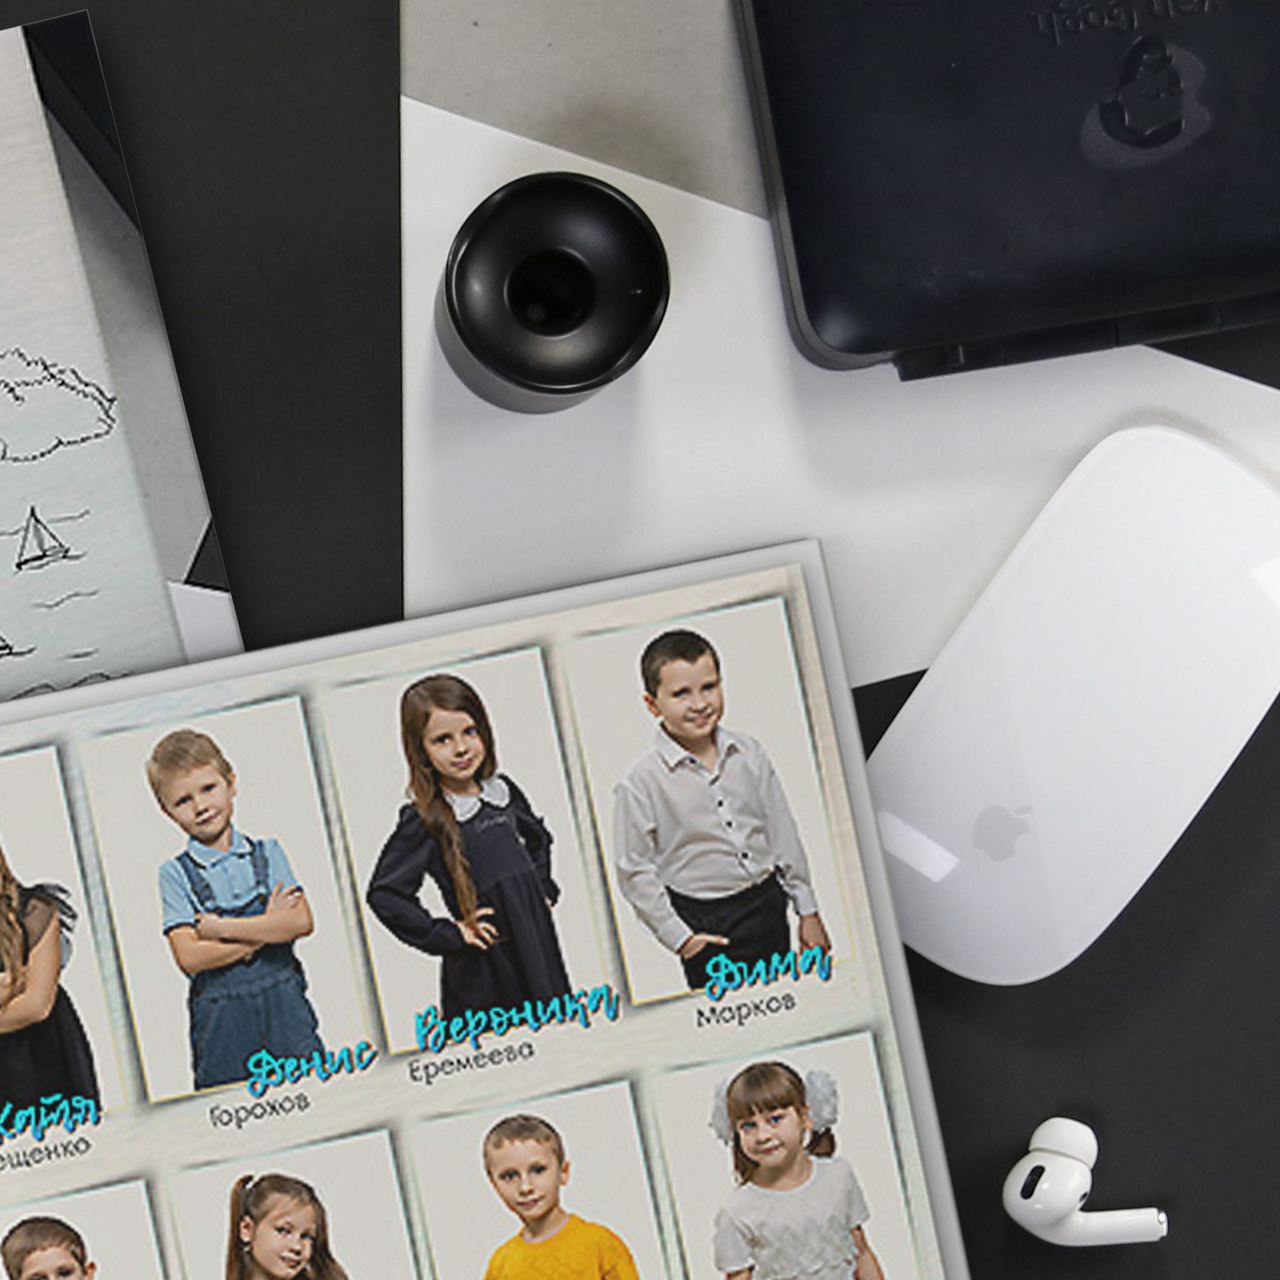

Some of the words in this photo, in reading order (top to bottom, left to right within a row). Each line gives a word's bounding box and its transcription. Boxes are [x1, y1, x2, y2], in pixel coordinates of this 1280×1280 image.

[704, 945, 832, 1002] Дима
[414, 983, 621, 1053] Вероника
[696, 992, 797, 1028] Марков
[246, 1040, 379, 1099] Денис
[407, 1042, 536, 1086] Еремеева
[208, 1092, 312, 1130] Горохов
